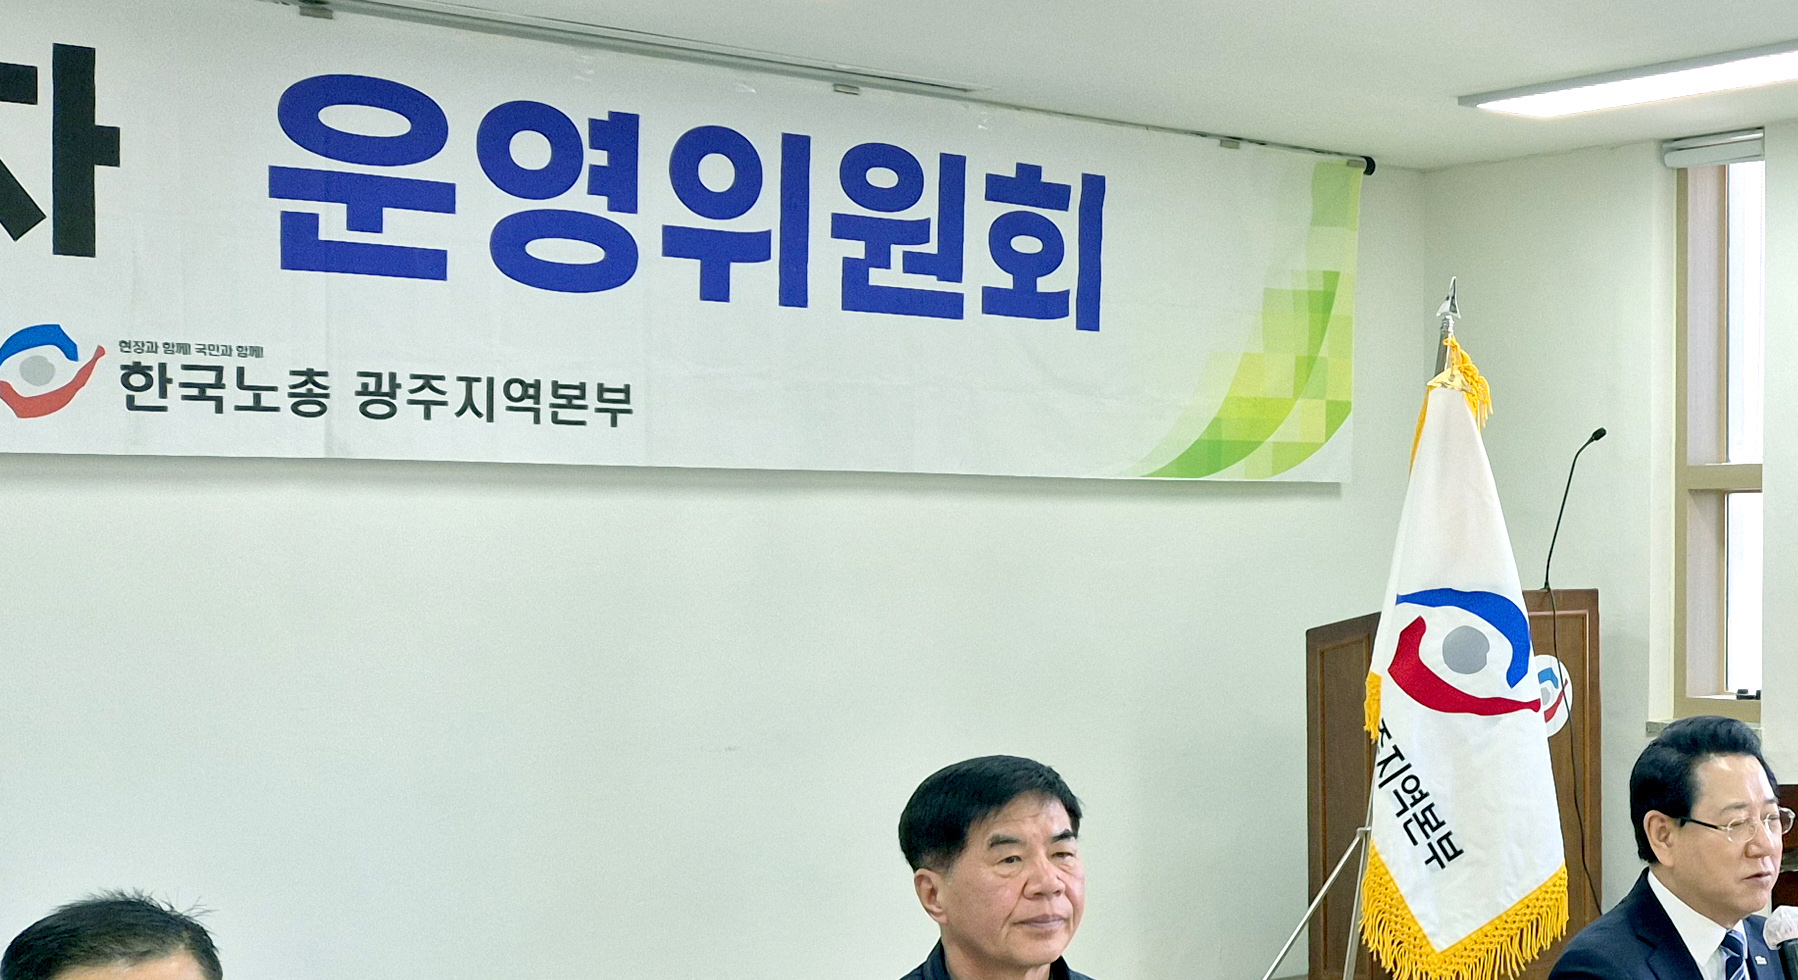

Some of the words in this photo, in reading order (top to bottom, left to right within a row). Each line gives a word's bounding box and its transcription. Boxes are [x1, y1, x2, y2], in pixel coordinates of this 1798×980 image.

[268, 73, 1106, 332] 운영위원회
[118, 339, 159, 355] 현장과
[194, 343, 233, 357] 국민과
[120, 361, 331, 418] 한국노총
[354, 370, 634, 428] 광주지역본부
